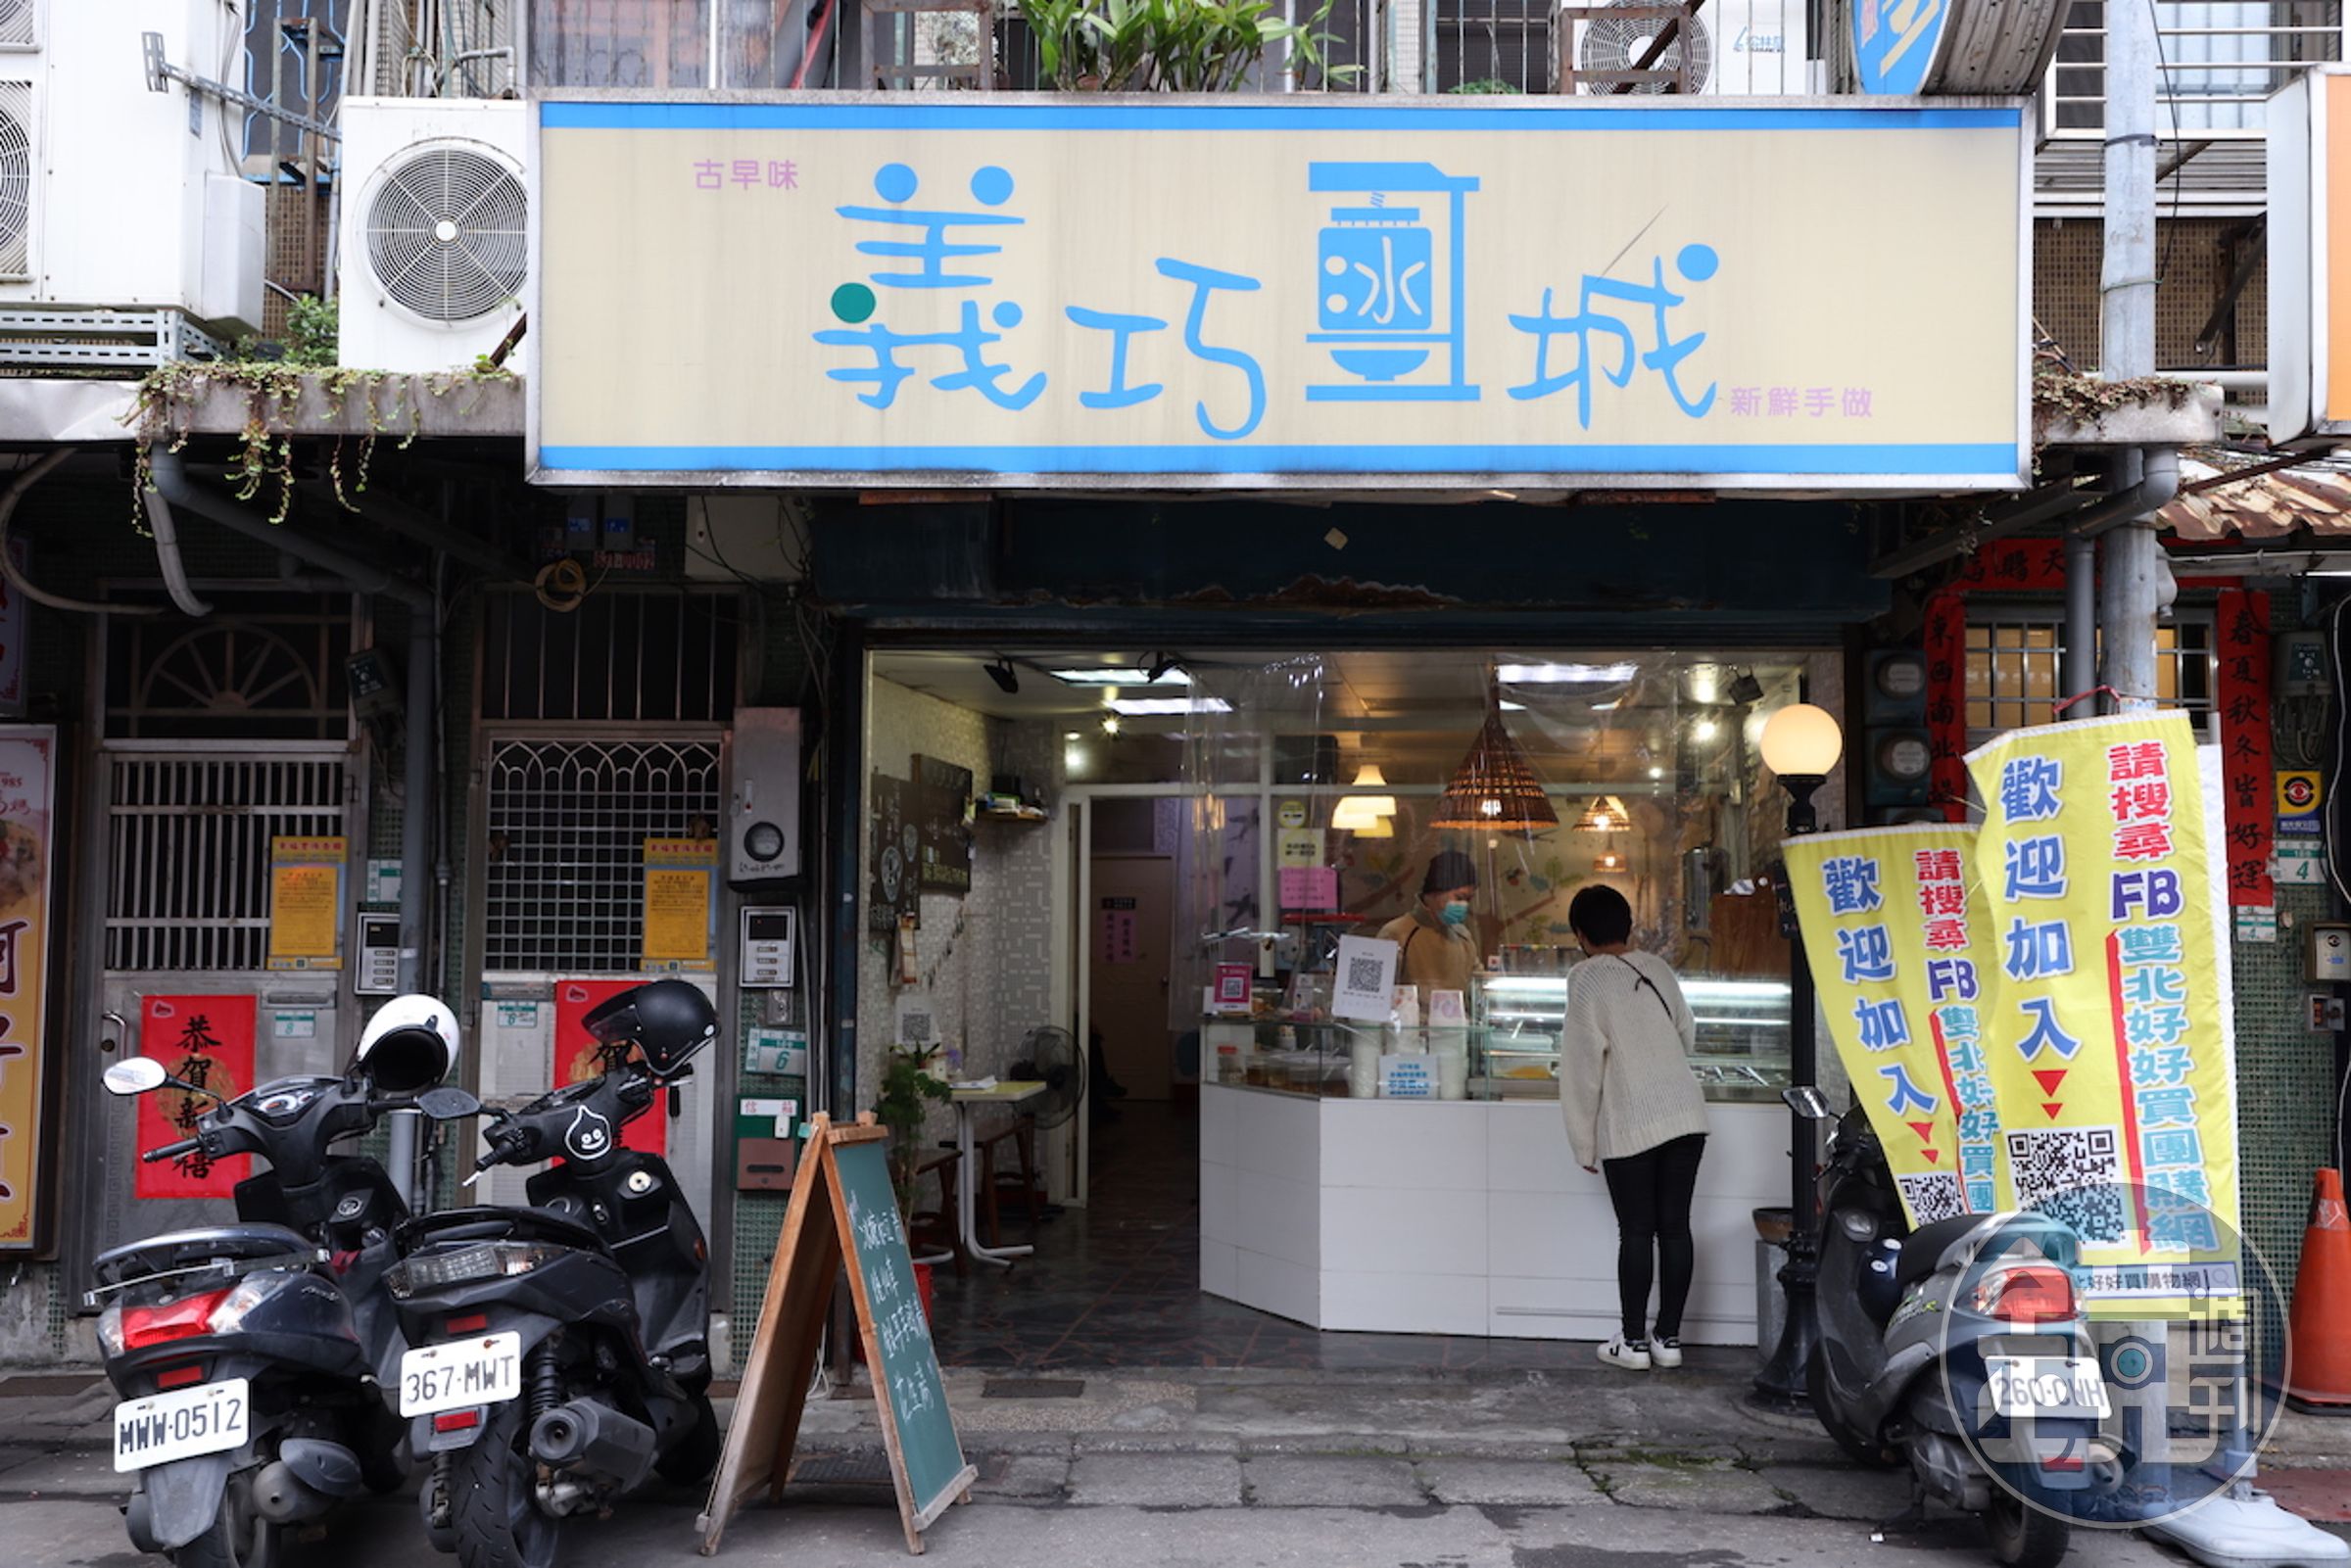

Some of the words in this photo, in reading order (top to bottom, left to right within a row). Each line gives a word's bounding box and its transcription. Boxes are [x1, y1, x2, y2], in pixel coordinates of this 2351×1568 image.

[694, 159, 798, 191] 古早味
[1730, 387, 1874, 418] 新鮮手做
[2001, 757, 2081, 1060] 歡迎加入
[1822, 856, 1938, 1114] 歡迎加入
[776, 1051, 791, 1069] 6
